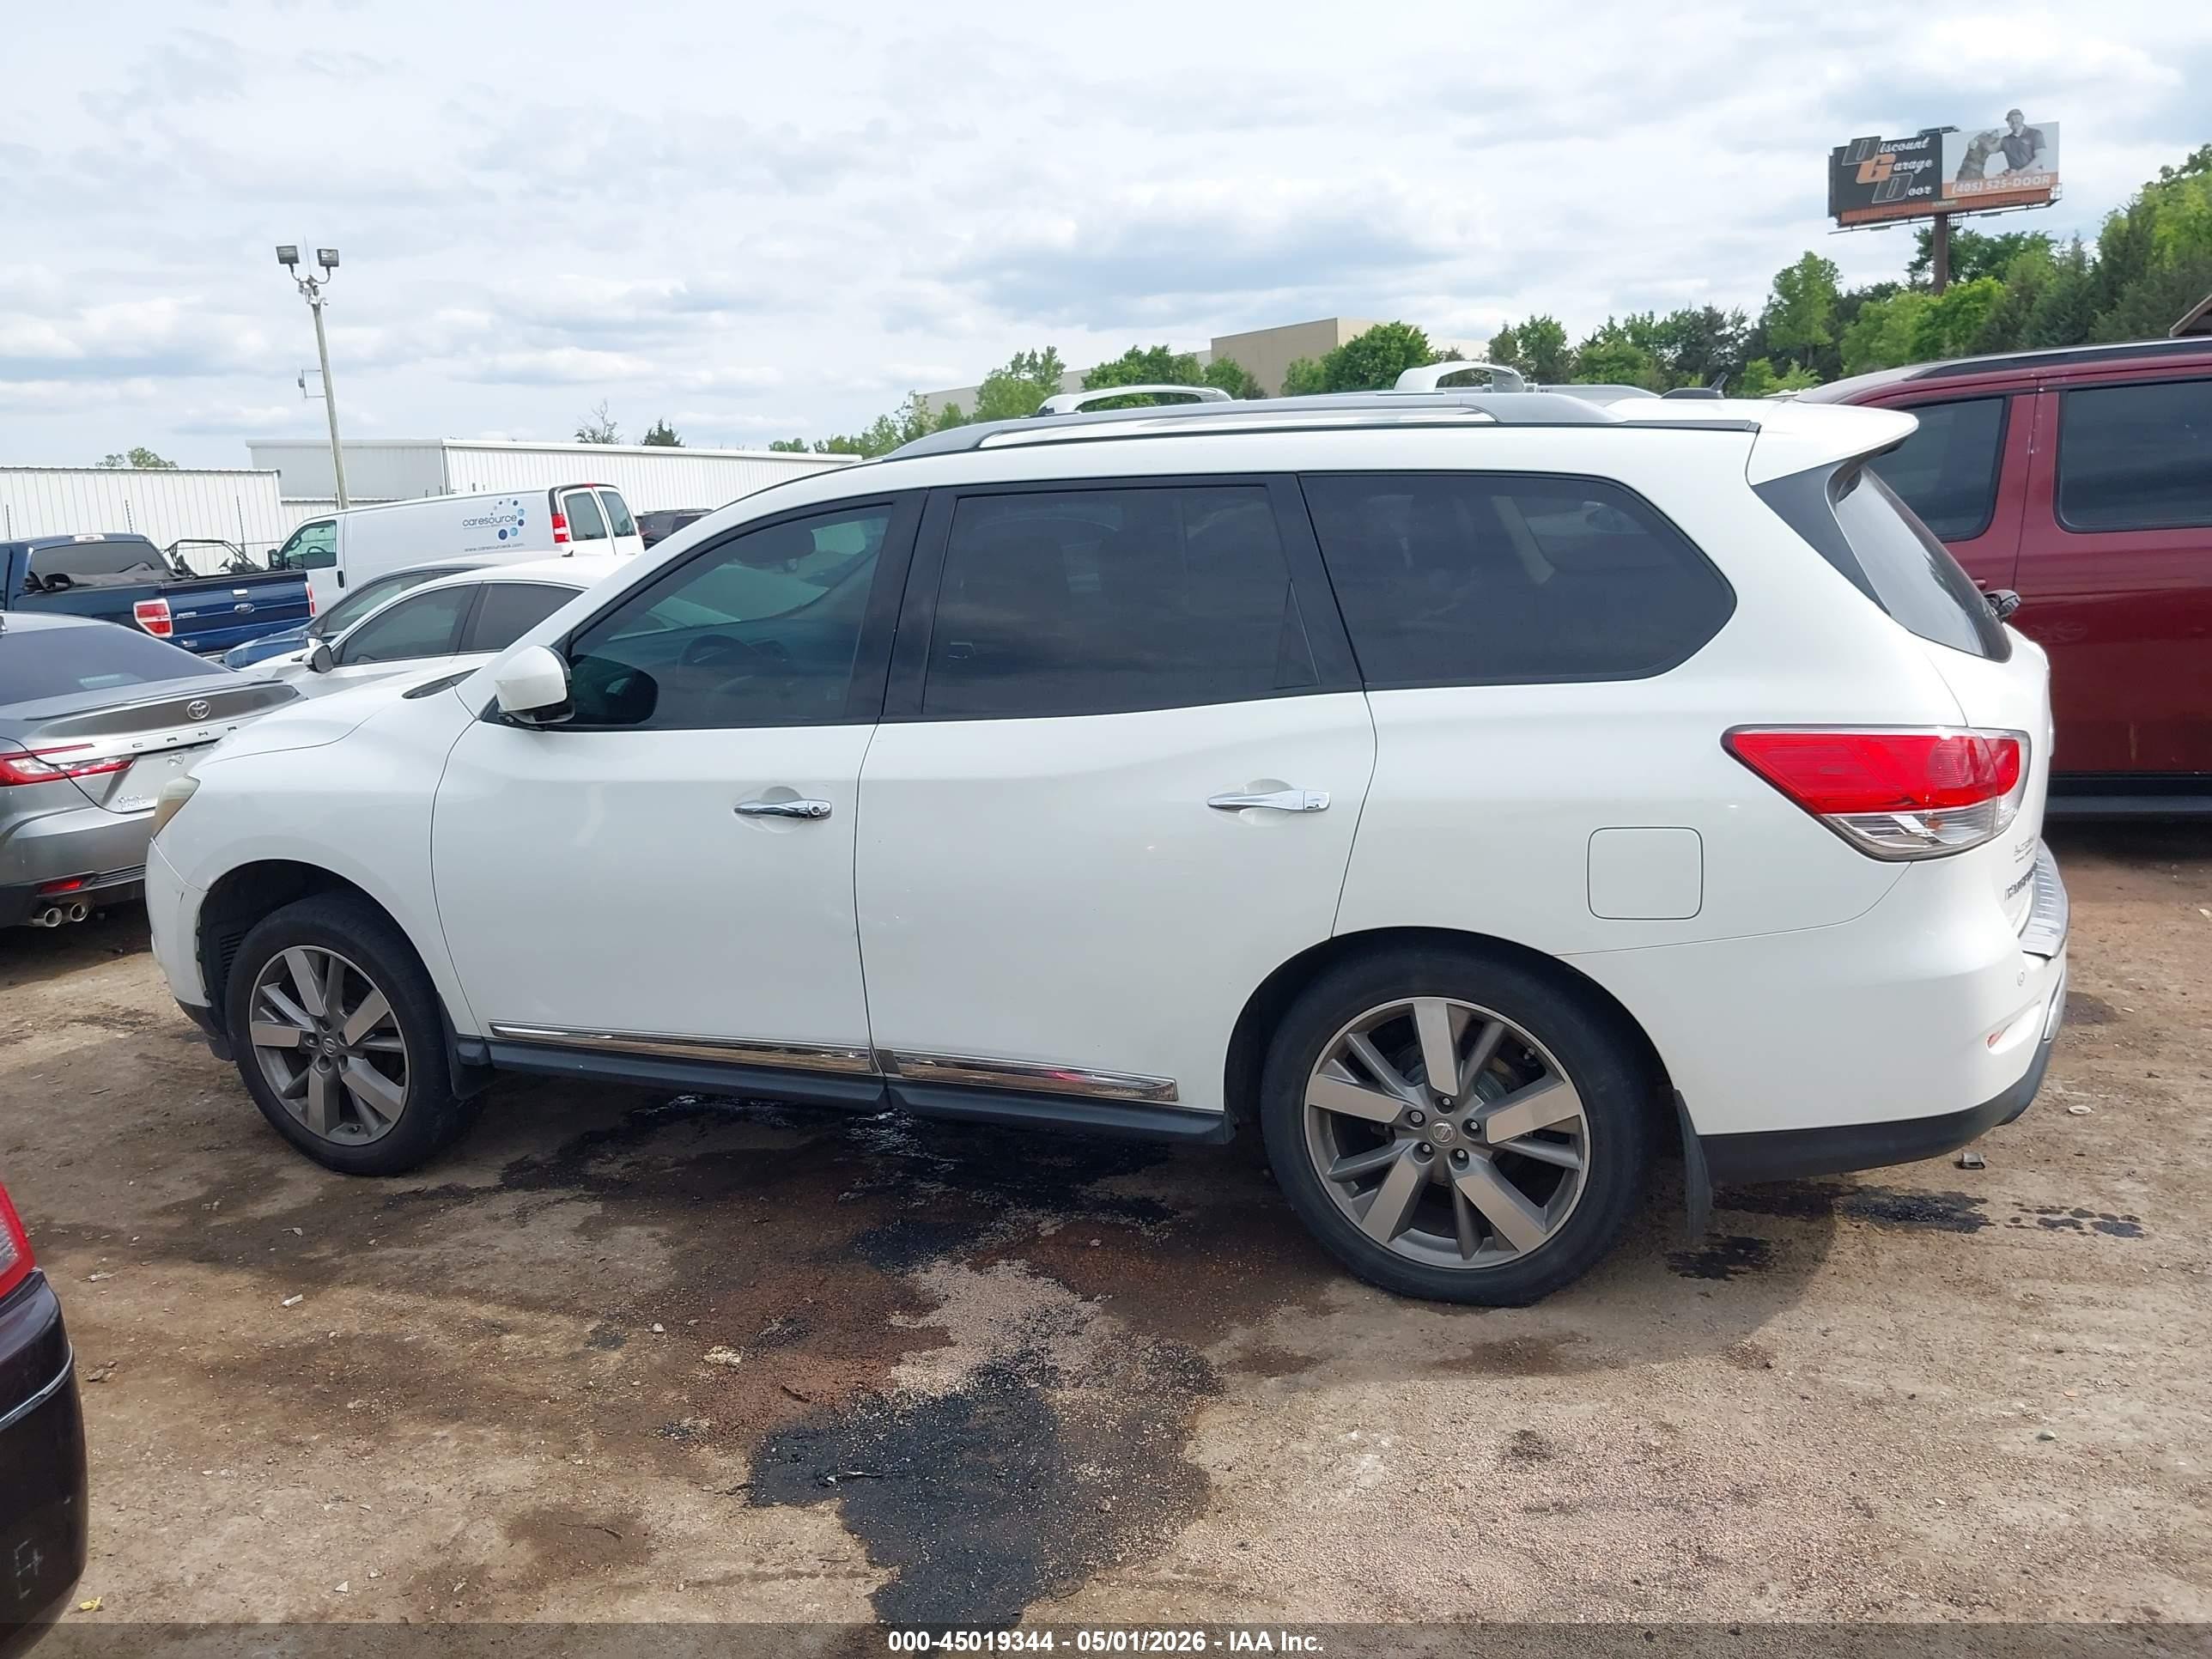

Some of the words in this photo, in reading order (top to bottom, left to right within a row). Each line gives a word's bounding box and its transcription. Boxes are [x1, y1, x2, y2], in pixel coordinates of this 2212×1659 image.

[1841, 136, 1930, 166] Discount
[1856, 154, 1933, 184] Garage
[1871, 173, 1932, 204] Door
[1951, 181, 1983, 195] (405)
[1986, 174, 2051, 191] 525-DOOR
[462, 514, 517, 527] caresource
[131, 725, 238, 749] CAMR
